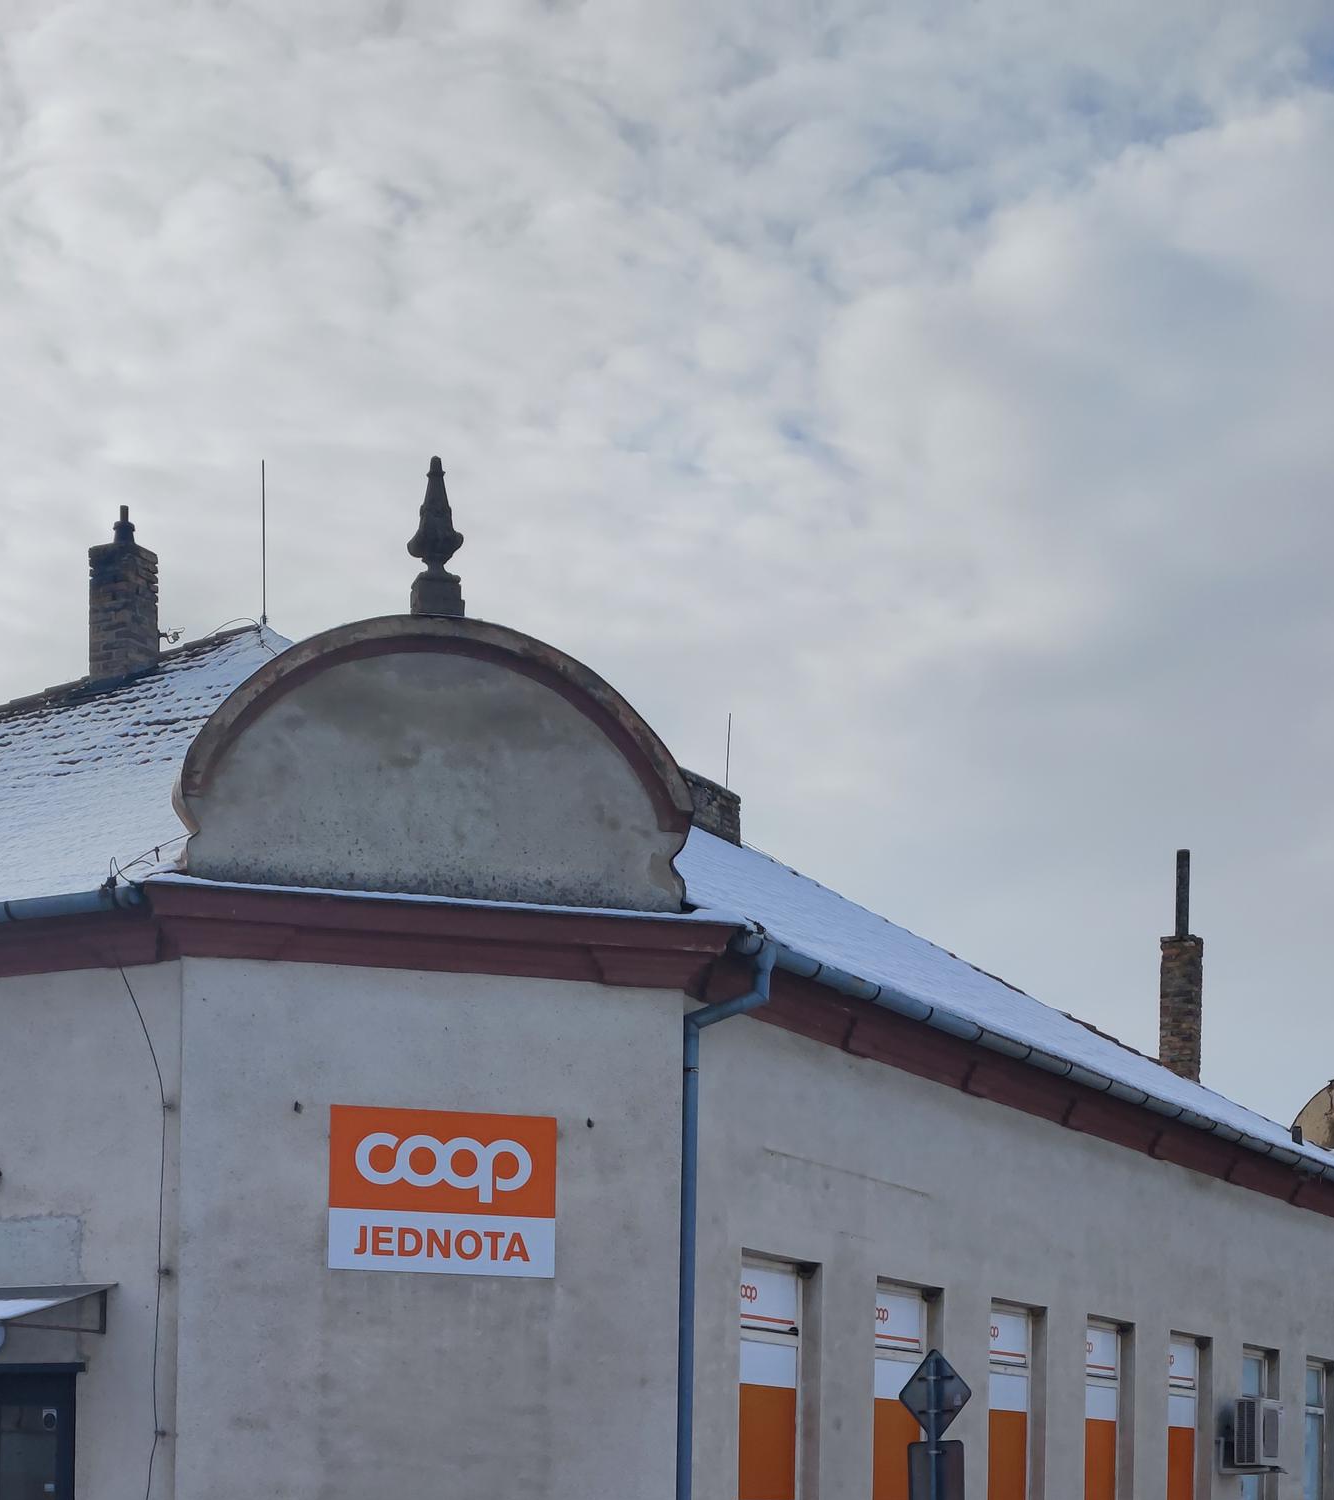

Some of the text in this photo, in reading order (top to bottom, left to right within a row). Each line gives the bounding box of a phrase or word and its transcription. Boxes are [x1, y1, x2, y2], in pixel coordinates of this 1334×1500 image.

[355, 1132, 533, 1204] coop
[353, 1225, 531, 1262] JEDNOTA
[740, 1284, 758, 1303] oop
